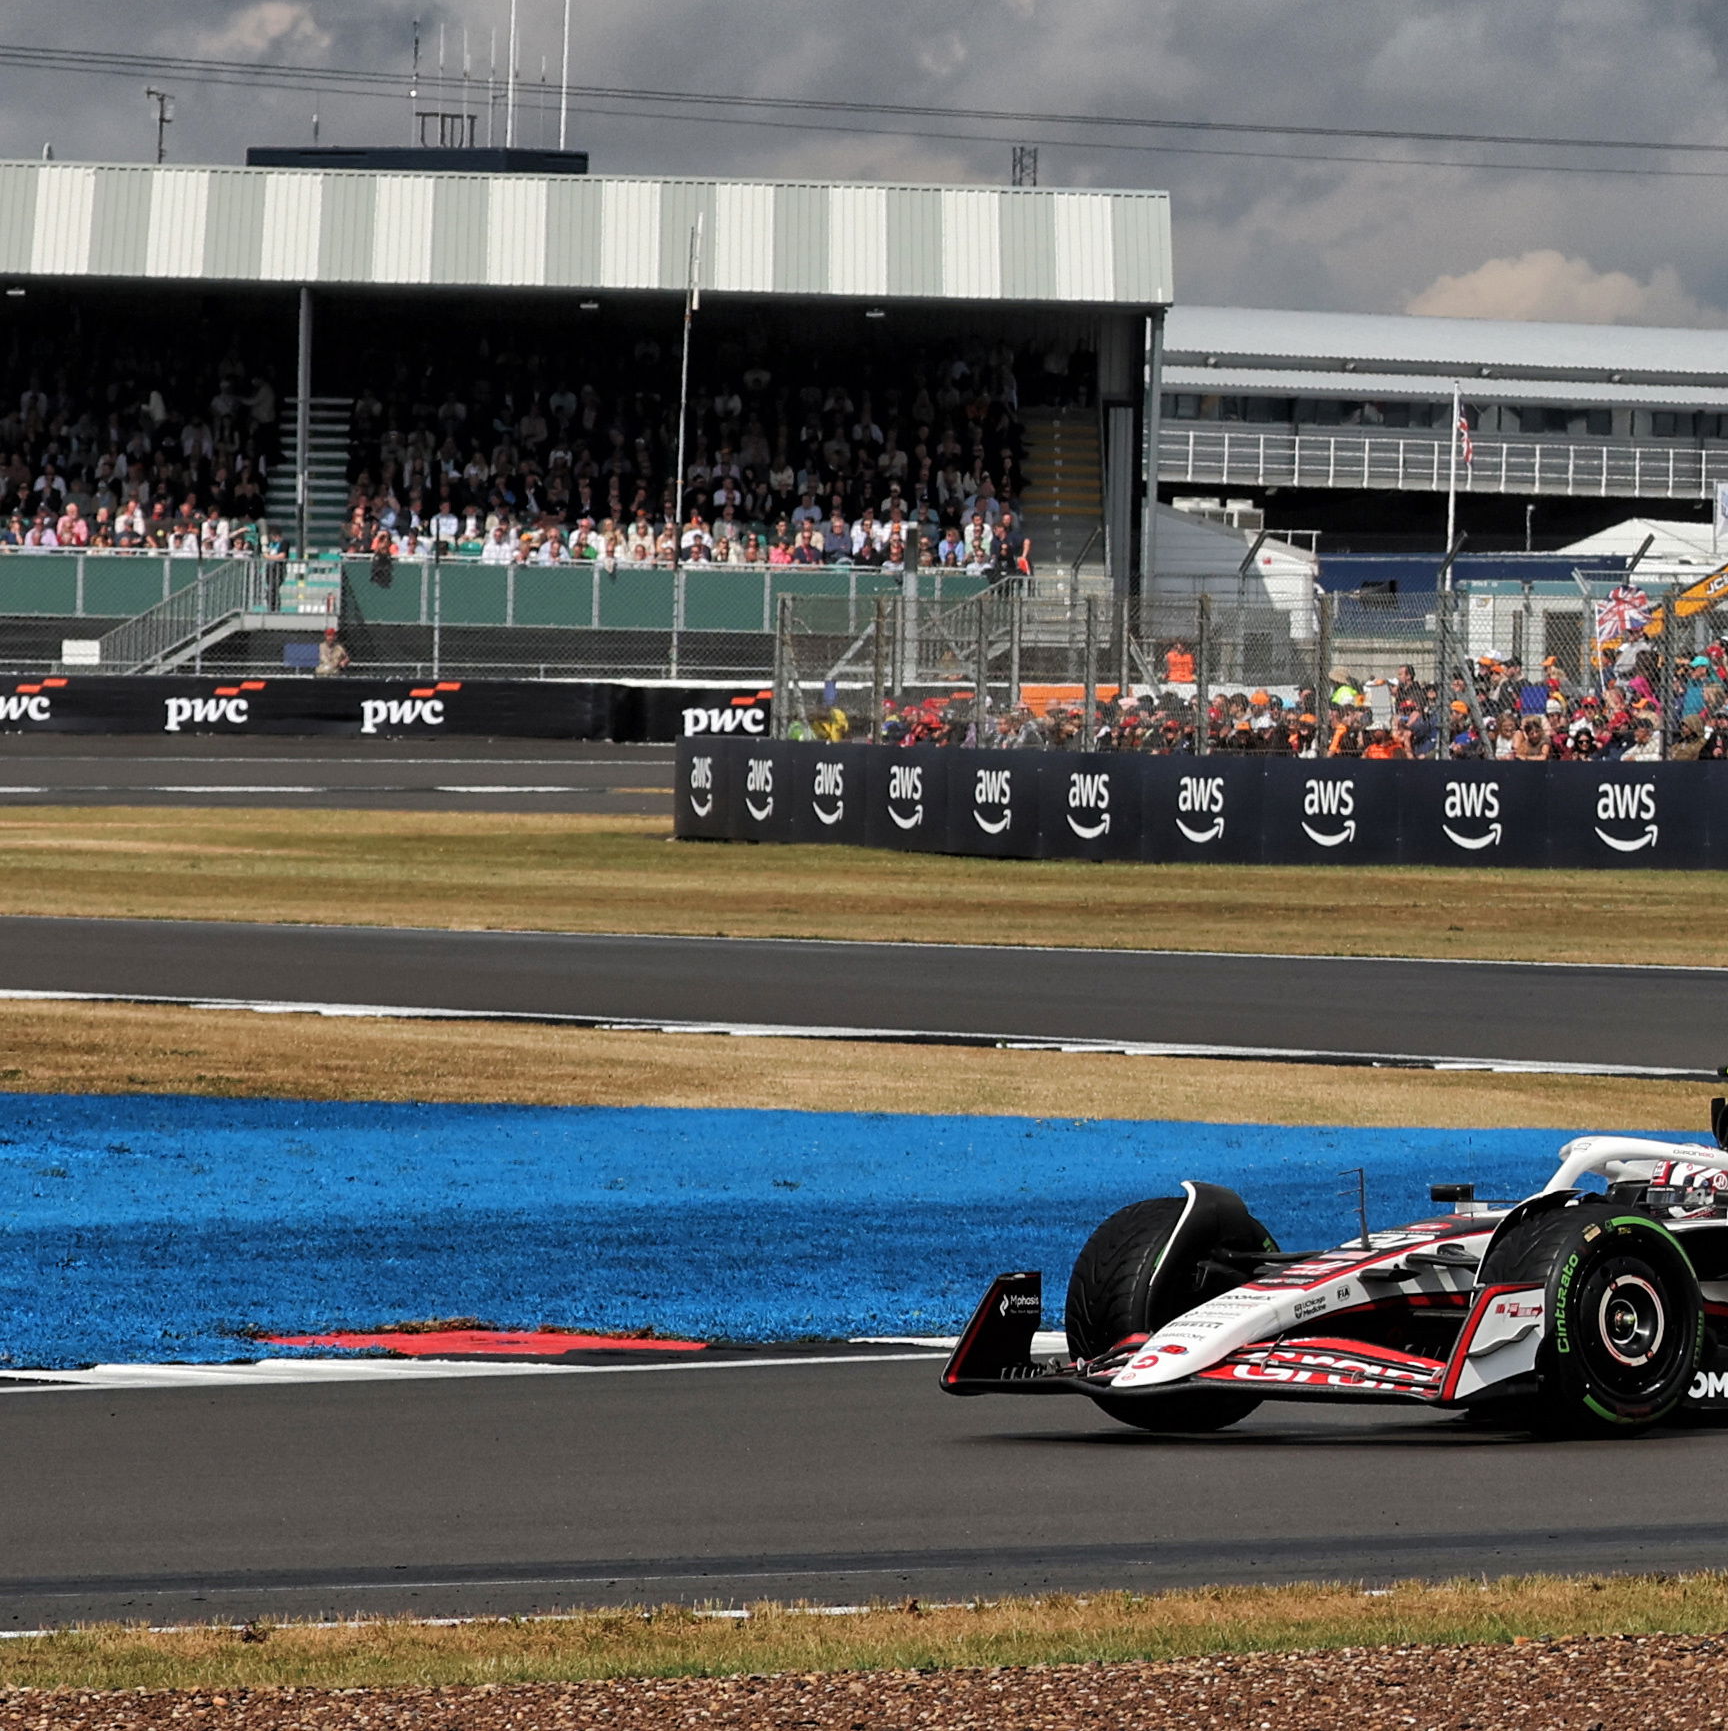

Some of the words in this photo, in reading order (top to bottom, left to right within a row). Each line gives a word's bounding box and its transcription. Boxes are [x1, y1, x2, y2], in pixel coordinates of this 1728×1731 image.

[0, 695, 51, 722] wc
[164, 697, 249, 731] pwc
[361, 699, 444, 734] pwc
[682, 708, 765, 737] pwc
[690, 756, 713, 790] aws
[746, 758, 773, 793] aws
[814, 761, 844, 797] aws
[889, 765, 923, 801] aws
[975, 769, 1011, 805] aws
[1068, 772, 1110, 809] aws
[1178, 776, 1224, 813] aws
[1304, 779, 1354, 816] aws
[1444, 781, 1500, 819] aws
[1597, 782, 1656, 820] aws
[1010, 1294, 1039, 1308] Mphasis
[1303, 1303, 1327, 1318] Medicine
[1554, 1253, 1579, 1354] Cinturato
